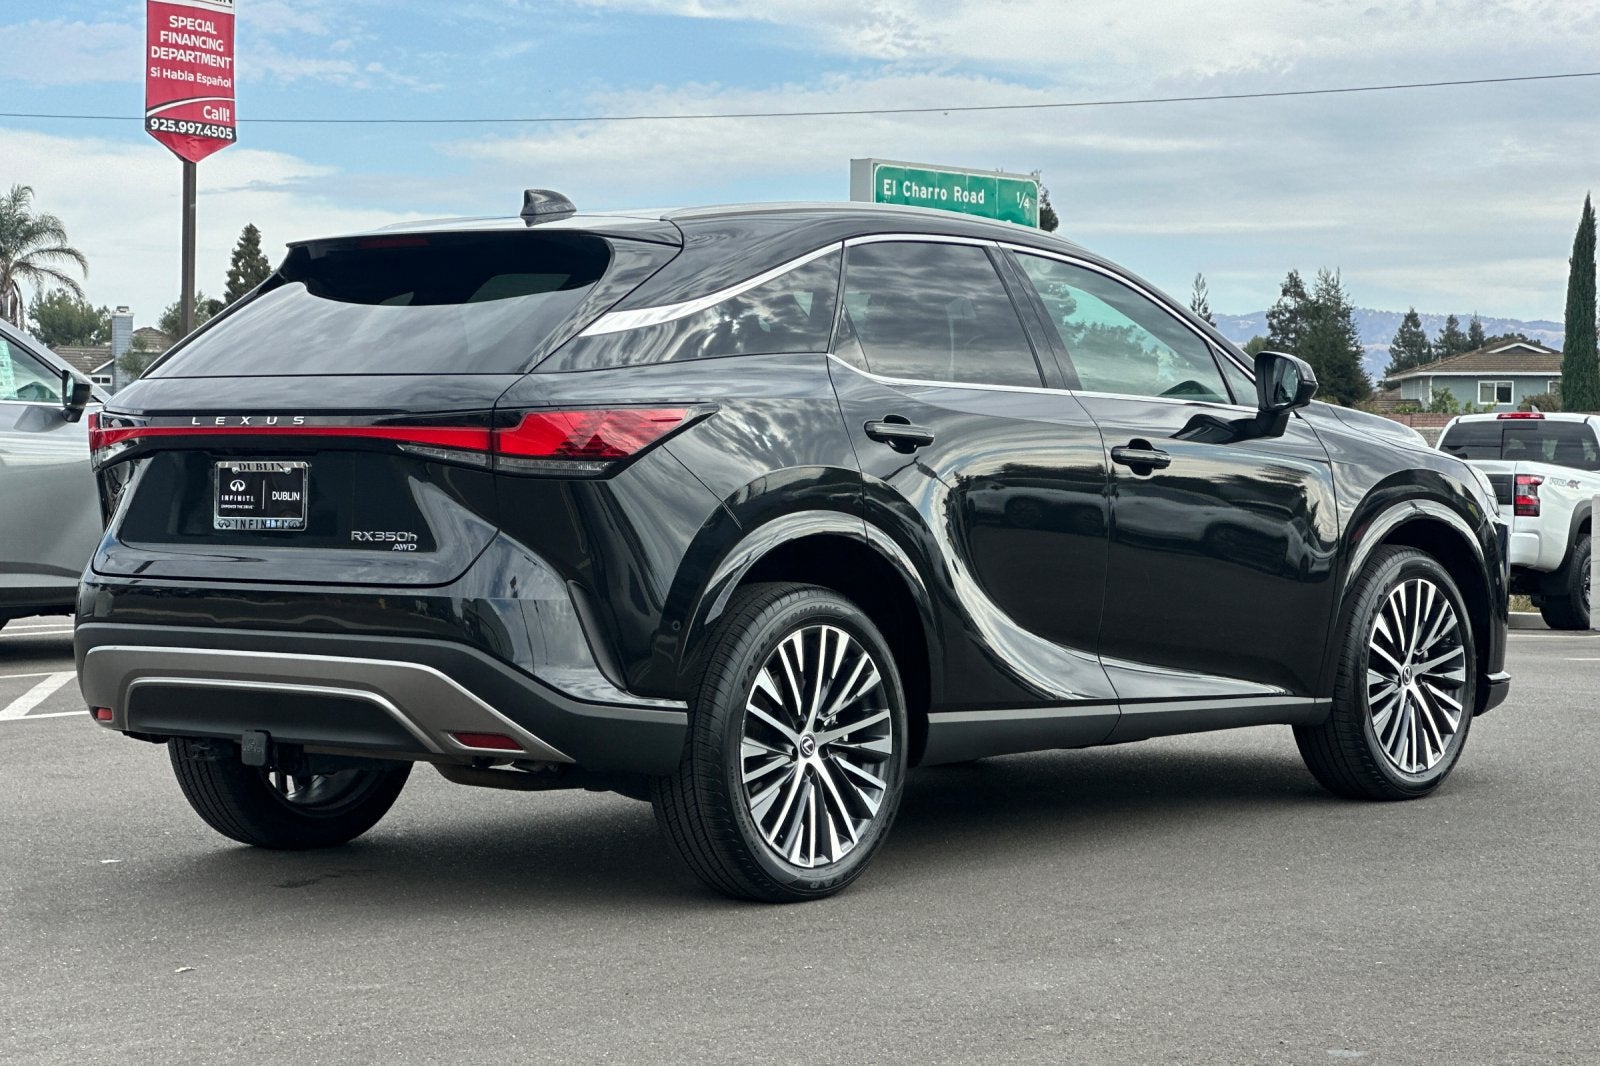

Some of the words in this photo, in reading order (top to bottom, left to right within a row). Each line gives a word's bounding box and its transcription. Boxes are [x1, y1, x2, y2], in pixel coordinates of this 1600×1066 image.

[169, 15, 217, 35] SPECIAL
[160, 30, 224, 52] FINANCING
[151, 45, 232, 69] DEPARTMENT
[150, 67, 160, 78] Si
[163, 68, 195, 82] Habla
[196, 72, 232, 88] Español
[203, 105, 230, 122] Call!
[150, 118, 233, 139] 925.997.4505
[883, 179, 896, 196] El
[902, 181, 948, 201] Charro
[954, 186, 985, 205] Road
[191, 415, 305, 426] LEXUS
[272, 491, 300, 501] DUBLIN
[350, 530, 418, 542] RX350h
[392, 543, 417, 551] AWD
